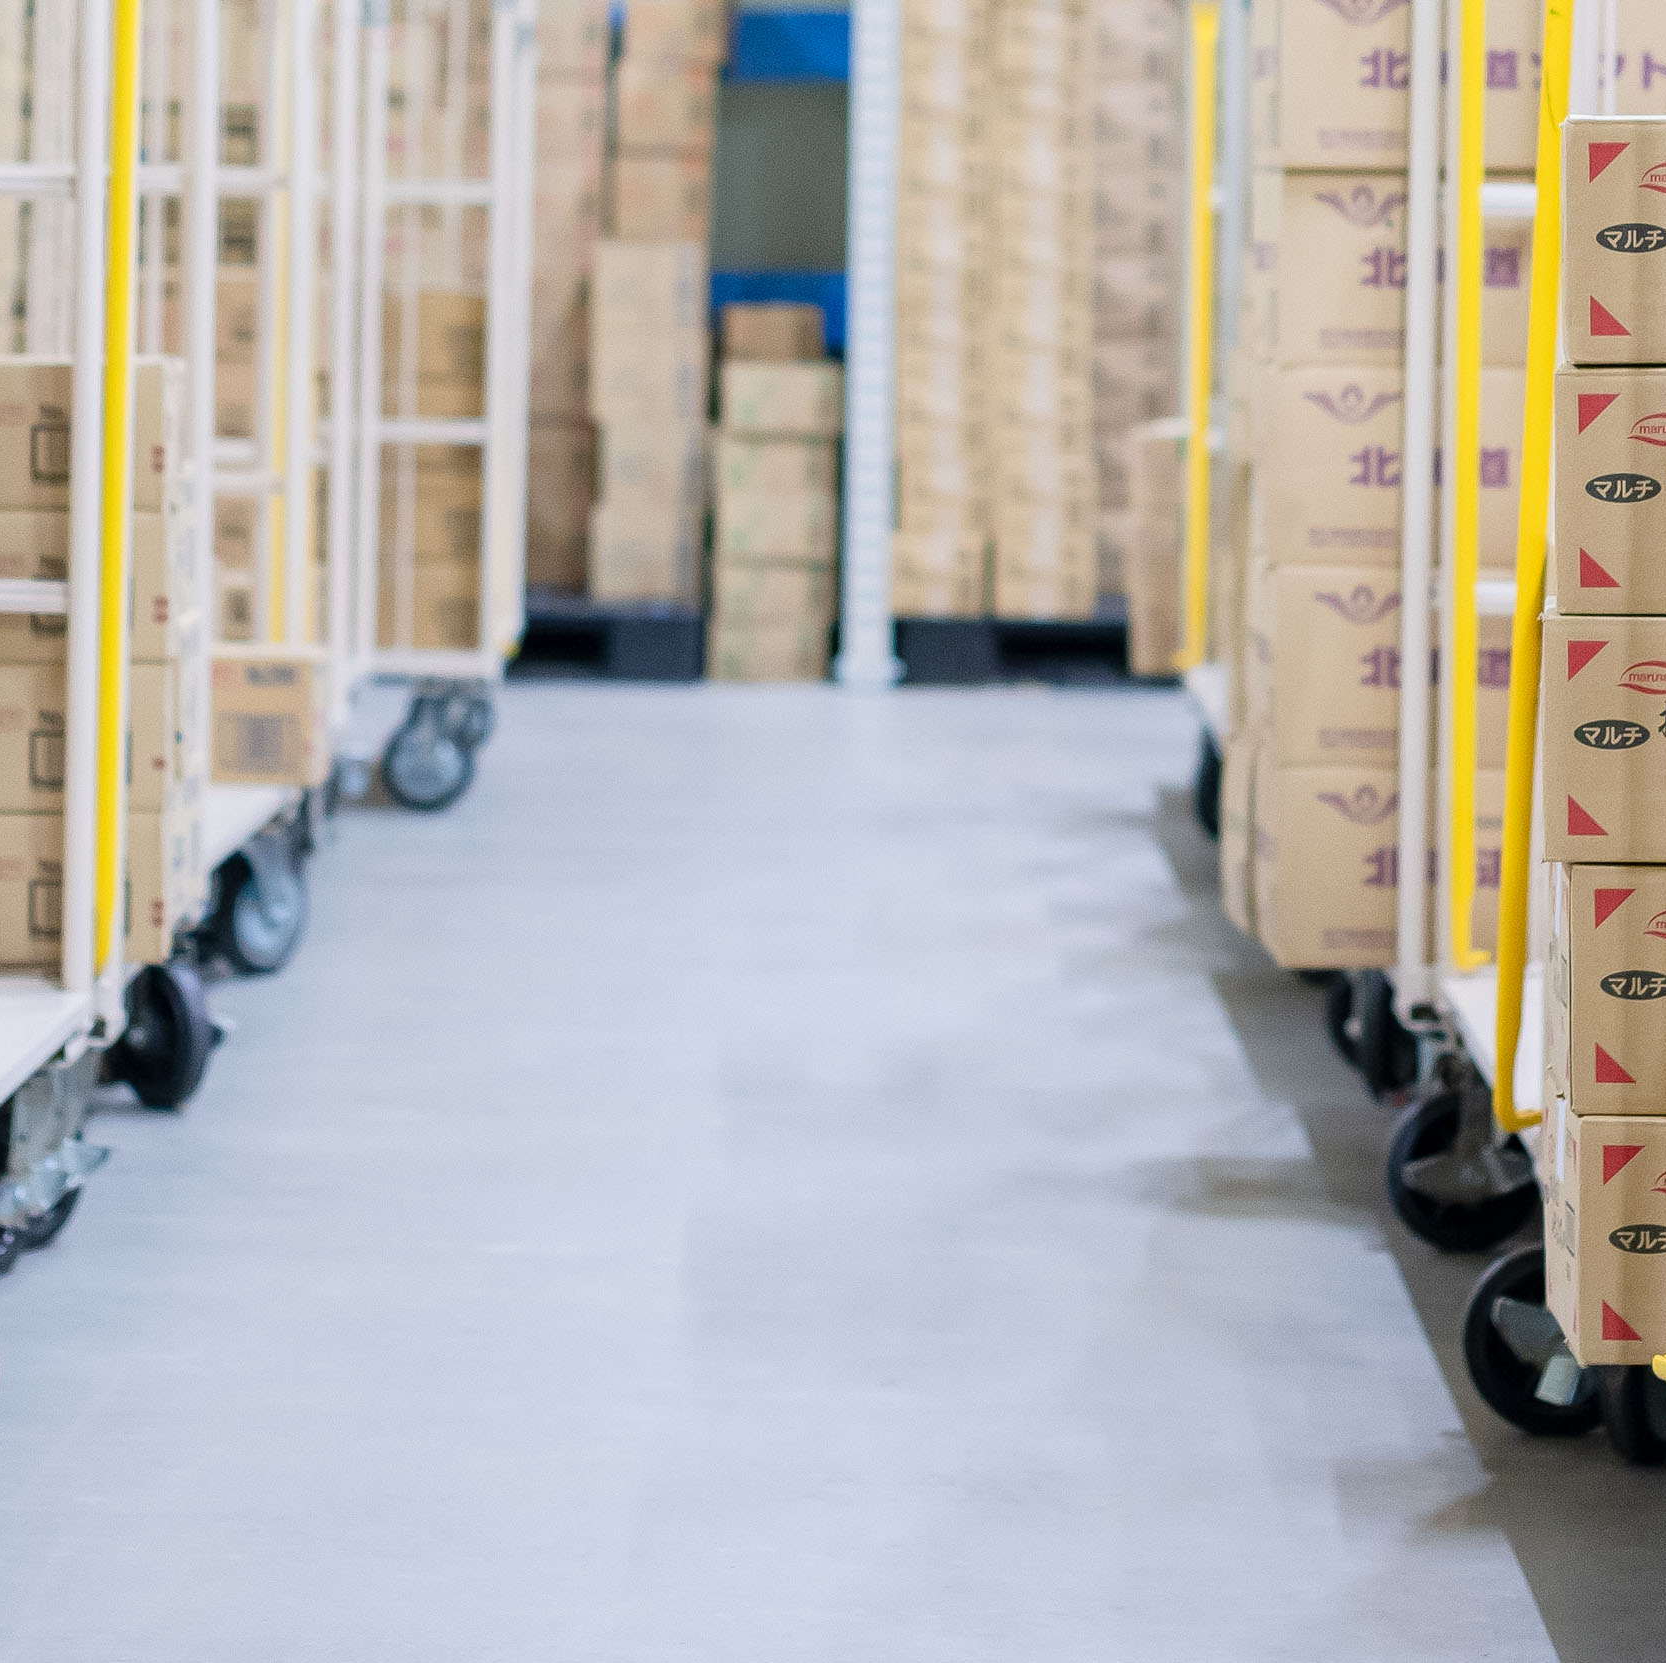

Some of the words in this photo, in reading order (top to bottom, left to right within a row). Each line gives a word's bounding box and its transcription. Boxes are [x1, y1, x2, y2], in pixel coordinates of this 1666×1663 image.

[1603, 229, 1666, 247] マルチ
[1592, 479, 1655, 497] マルチ
[1581, 726, 1643, 744] マルチ
